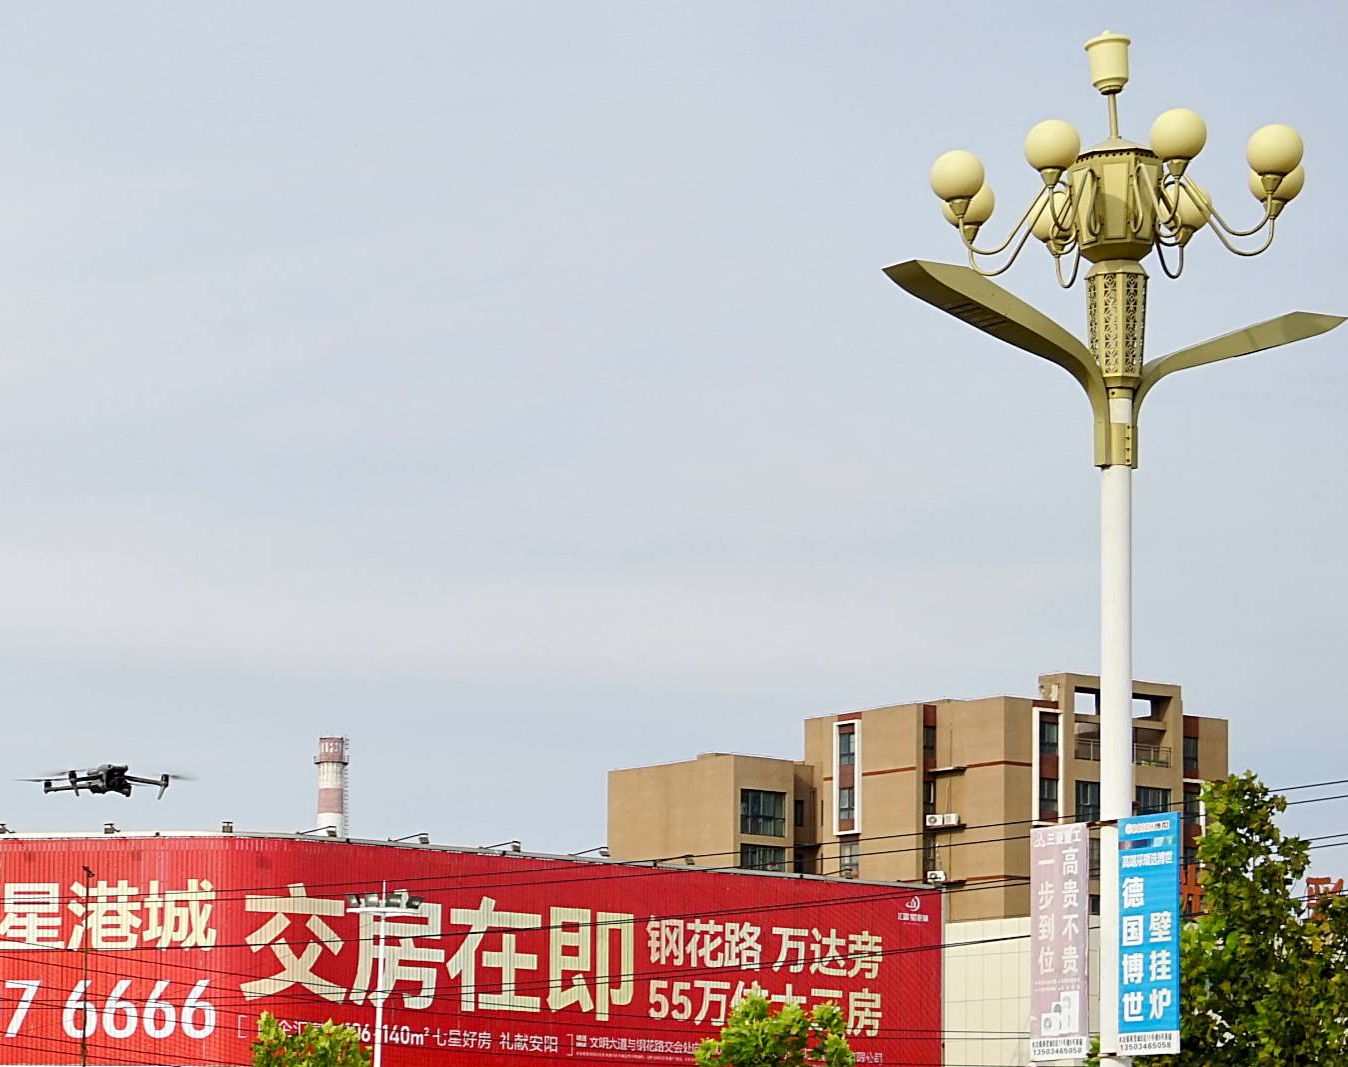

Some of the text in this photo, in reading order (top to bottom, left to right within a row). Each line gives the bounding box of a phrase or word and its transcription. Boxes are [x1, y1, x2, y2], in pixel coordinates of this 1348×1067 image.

[239, 883, 634, 1022] 交房在即
[647, 915, 884, 981] 钢花路 万达旁
[1038, 858, 1055, 975] 一步到位
[1062, 848, 1079, 975] 高贵不贵
[1122, 877, 1144, 1022] 德国博世
[1149, 911, 1172, 1021] 壁挂炉
[62, 979, 217, 1039] 6666
[433, 1032, 492, 1050] 七星好房
[500, 1032, 559, 1053] 礼献安阳
